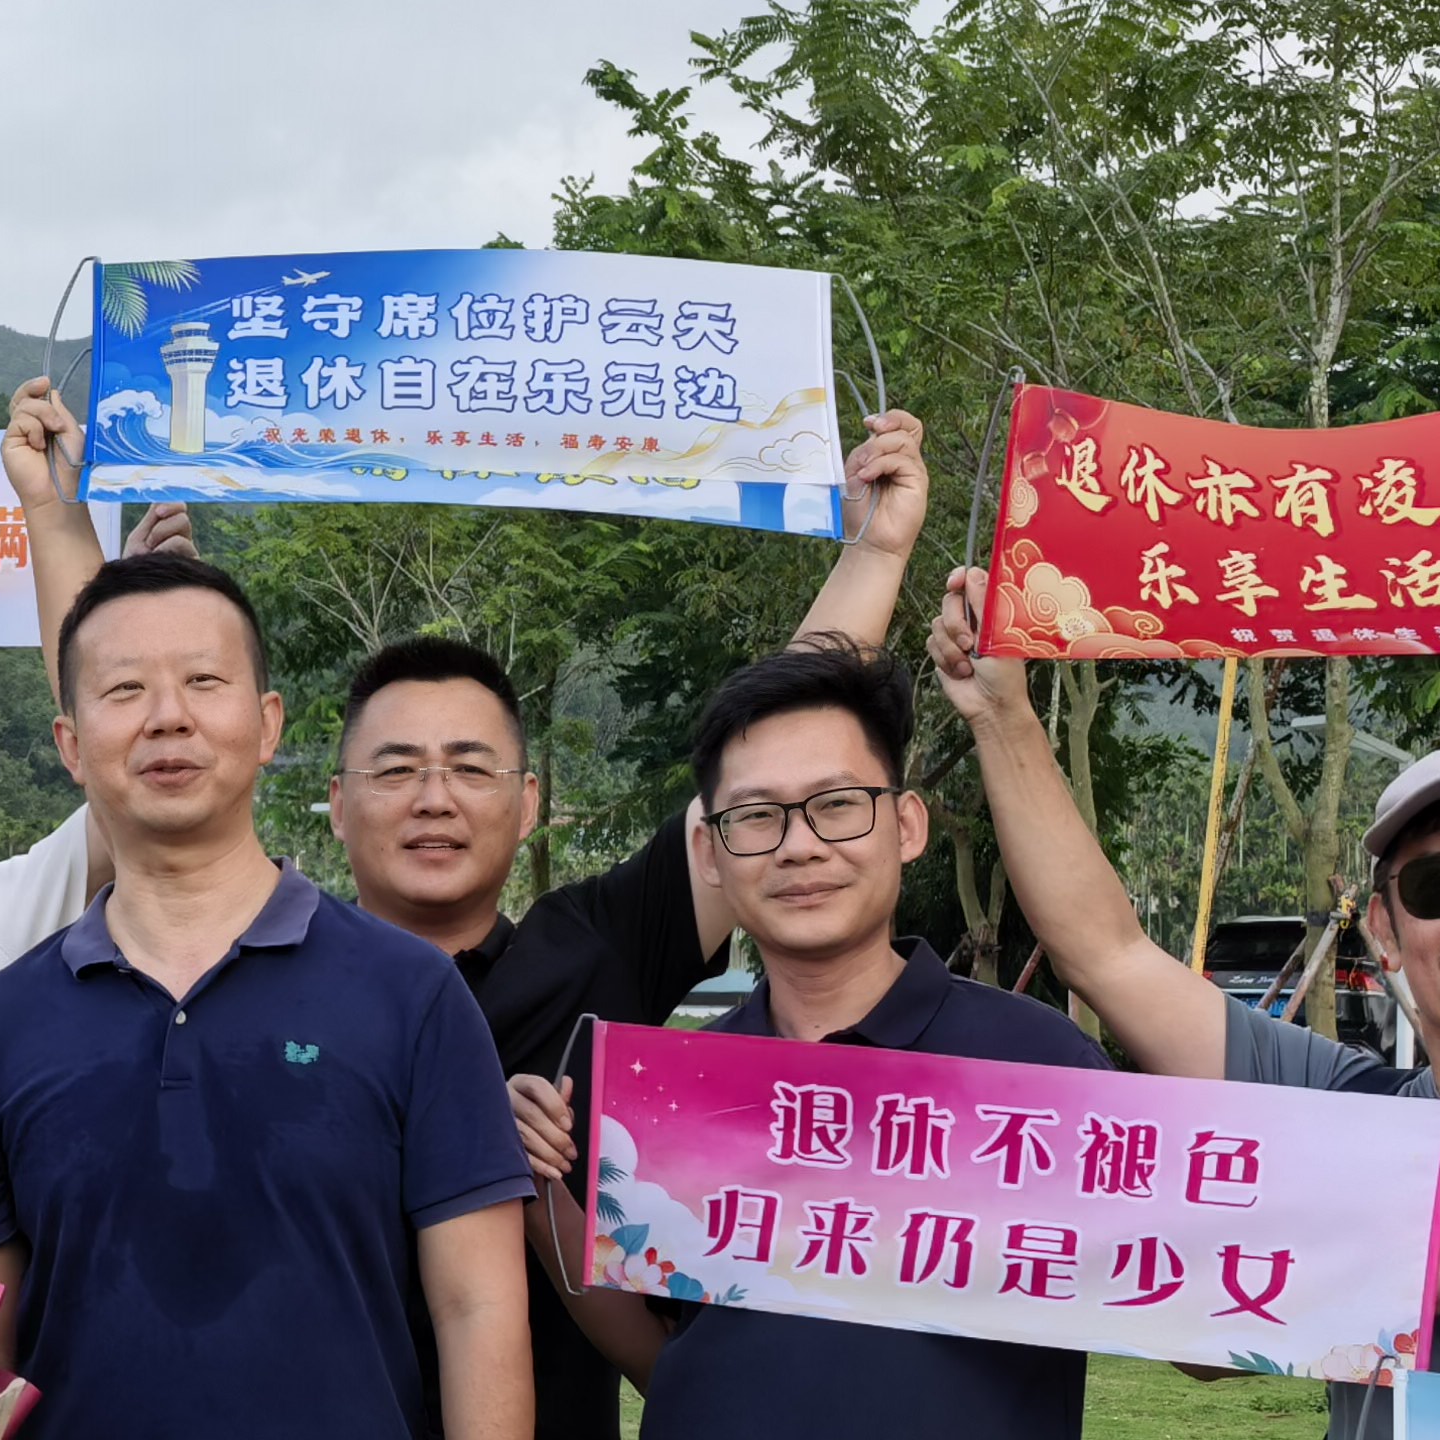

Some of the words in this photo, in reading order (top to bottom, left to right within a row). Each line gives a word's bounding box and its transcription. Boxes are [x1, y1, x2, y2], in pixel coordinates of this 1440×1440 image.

[225, 291, 739, 354] 坚守席位护云天
[224, 357, 742, 422] 退休自在乐无边
[770, 1082, 1263, 1209] 退休不褪色
[704, 1187, 1296, 1326] 归来仍是少女
